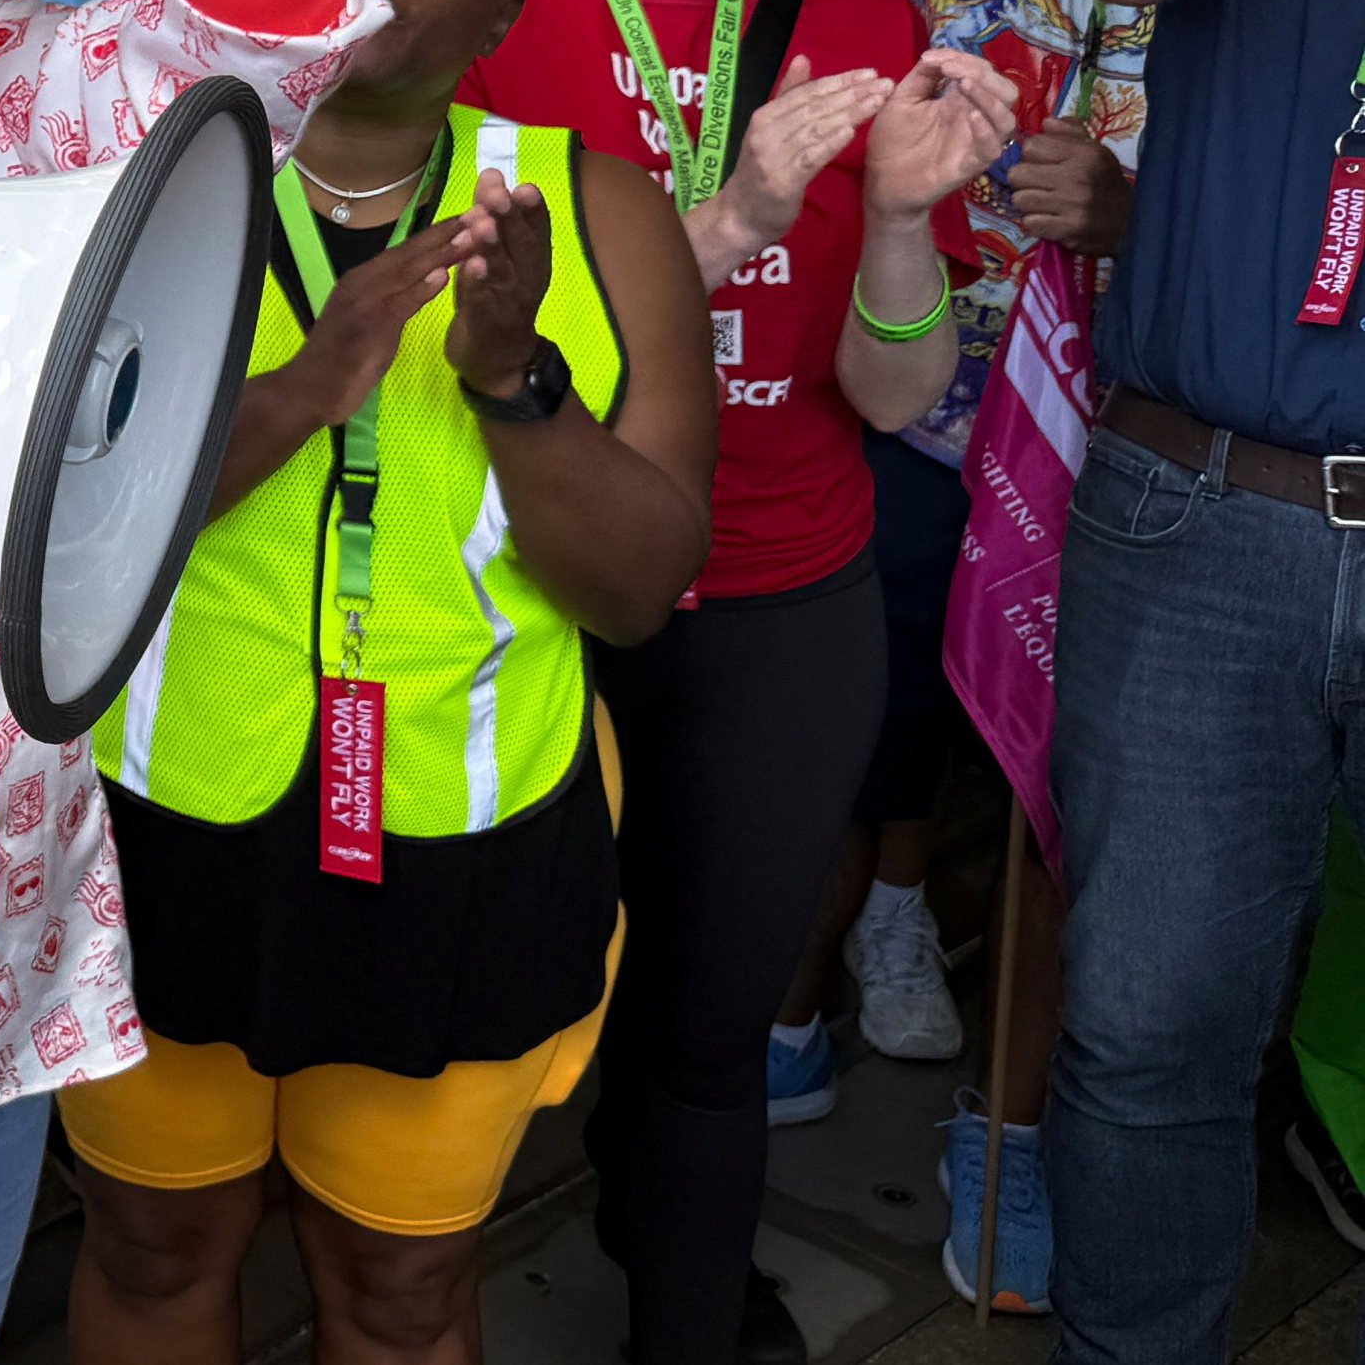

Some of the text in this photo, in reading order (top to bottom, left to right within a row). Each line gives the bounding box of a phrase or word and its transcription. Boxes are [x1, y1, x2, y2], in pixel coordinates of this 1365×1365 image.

[1315, 257, 1338, 291] FLY
[1330, 251, 1357, 295] WORK
[330, 697, 354, 780] WON'T
[354, 699, 374, 833] UNPAID WORK
[330, 782, 353, 828] FLY
